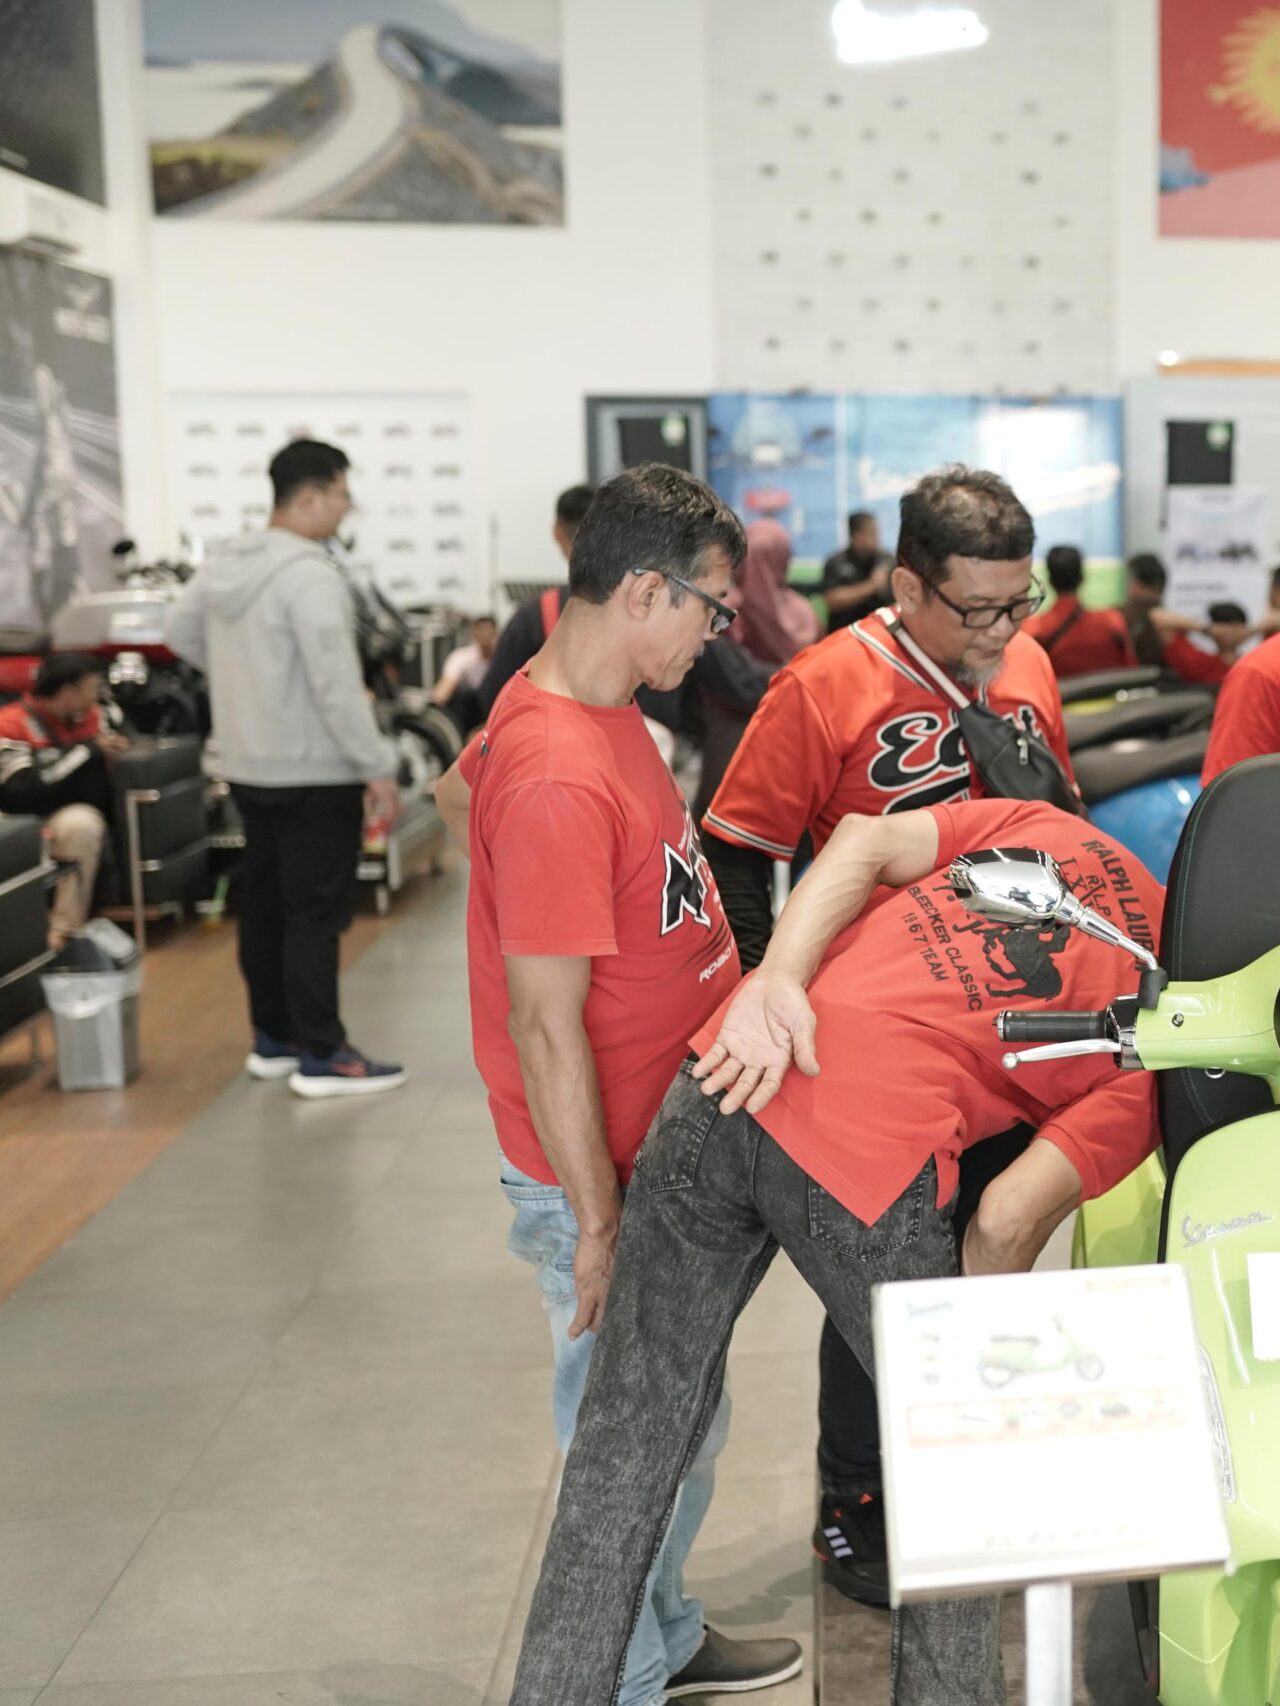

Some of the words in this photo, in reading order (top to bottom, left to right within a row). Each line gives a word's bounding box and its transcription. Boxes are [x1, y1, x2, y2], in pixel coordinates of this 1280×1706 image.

[1080, 838, 1135, 894] RALPH
[902, 911, 929, 946] 1967
[920, 947, 950, 982] TEAM
[906, 886, 951, 945] BLEECKER
[944, 946, 983, 1011] CLASSIC
